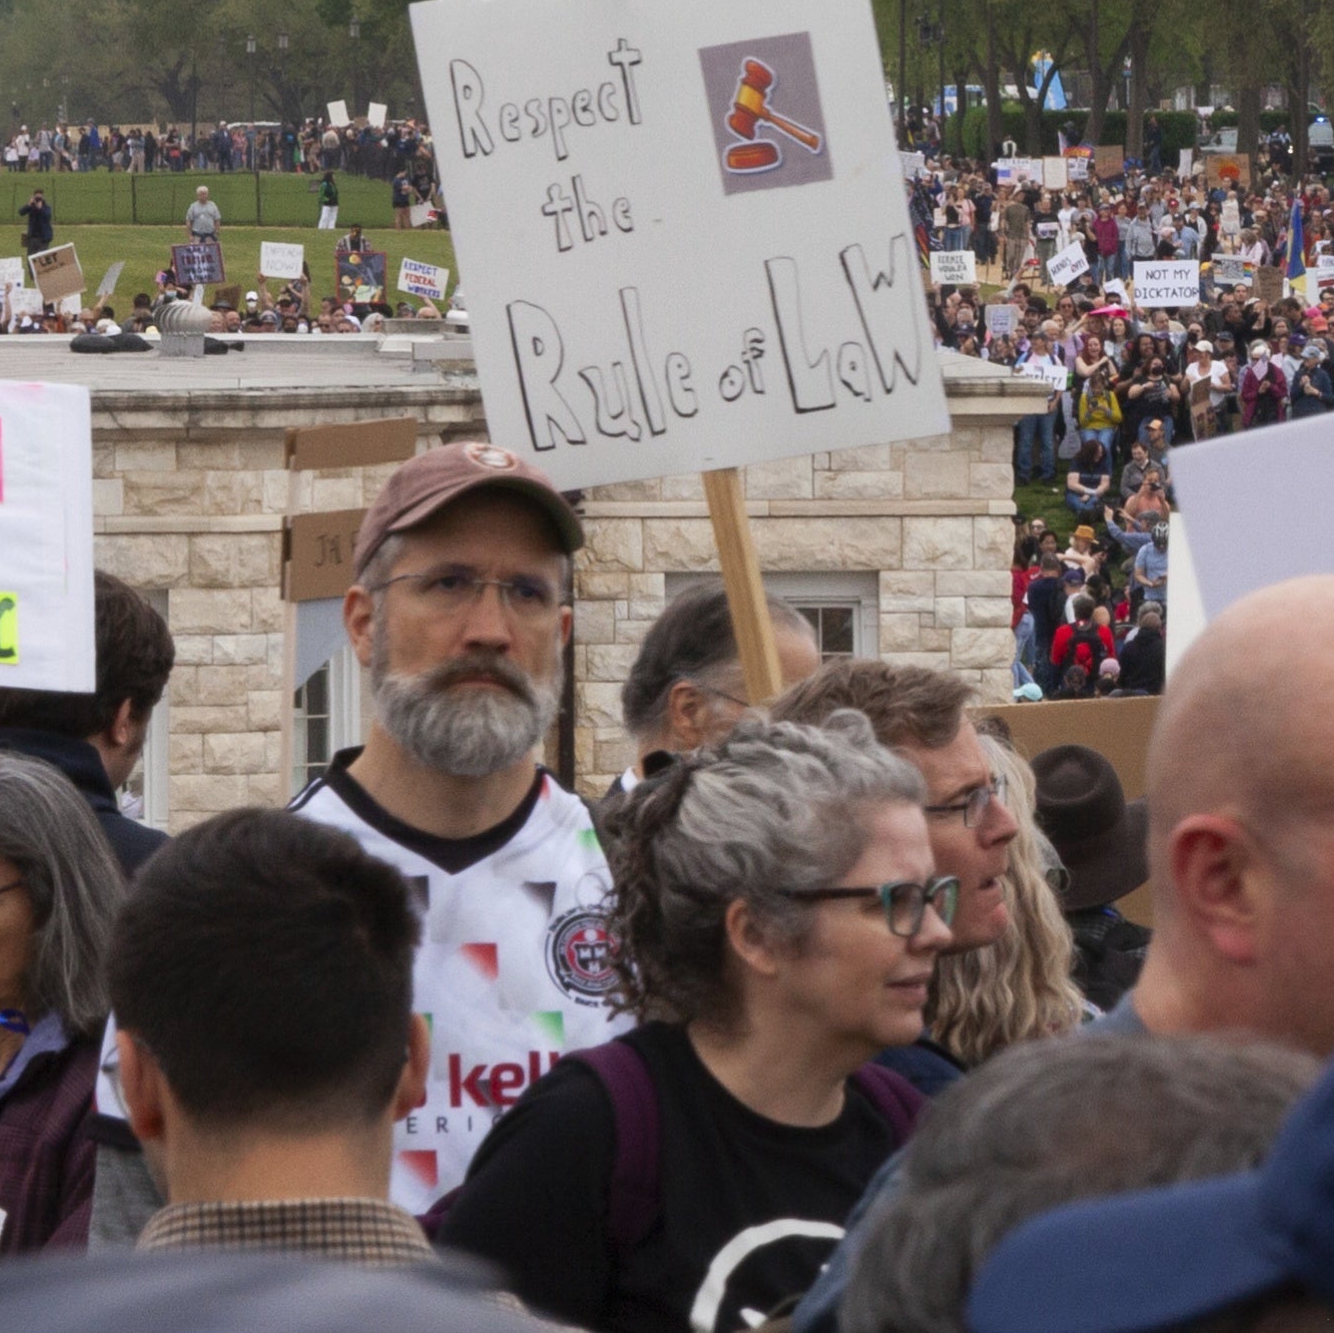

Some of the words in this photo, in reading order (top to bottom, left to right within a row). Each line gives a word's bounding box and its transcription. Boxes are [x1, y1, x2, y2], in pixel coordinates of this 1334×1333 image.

[449, 37, 643, 161] Respect
[540, 175, 635, 254] the
[403, 260, 438, 277] RESPECT
[1050, 256, 1072, 276] HANDS
[1145, 268, 1169, 280] NOT
[1173, 268, 1191, 280] MY
[404, 272, 437, 287] FEDERAL
[407, 283, 441, 298] WORKERS
[1134, 286, 1200, 299] DICKTATOR
[505, 286, 701, 452] Rule
[718, 326, 766, 402] of
